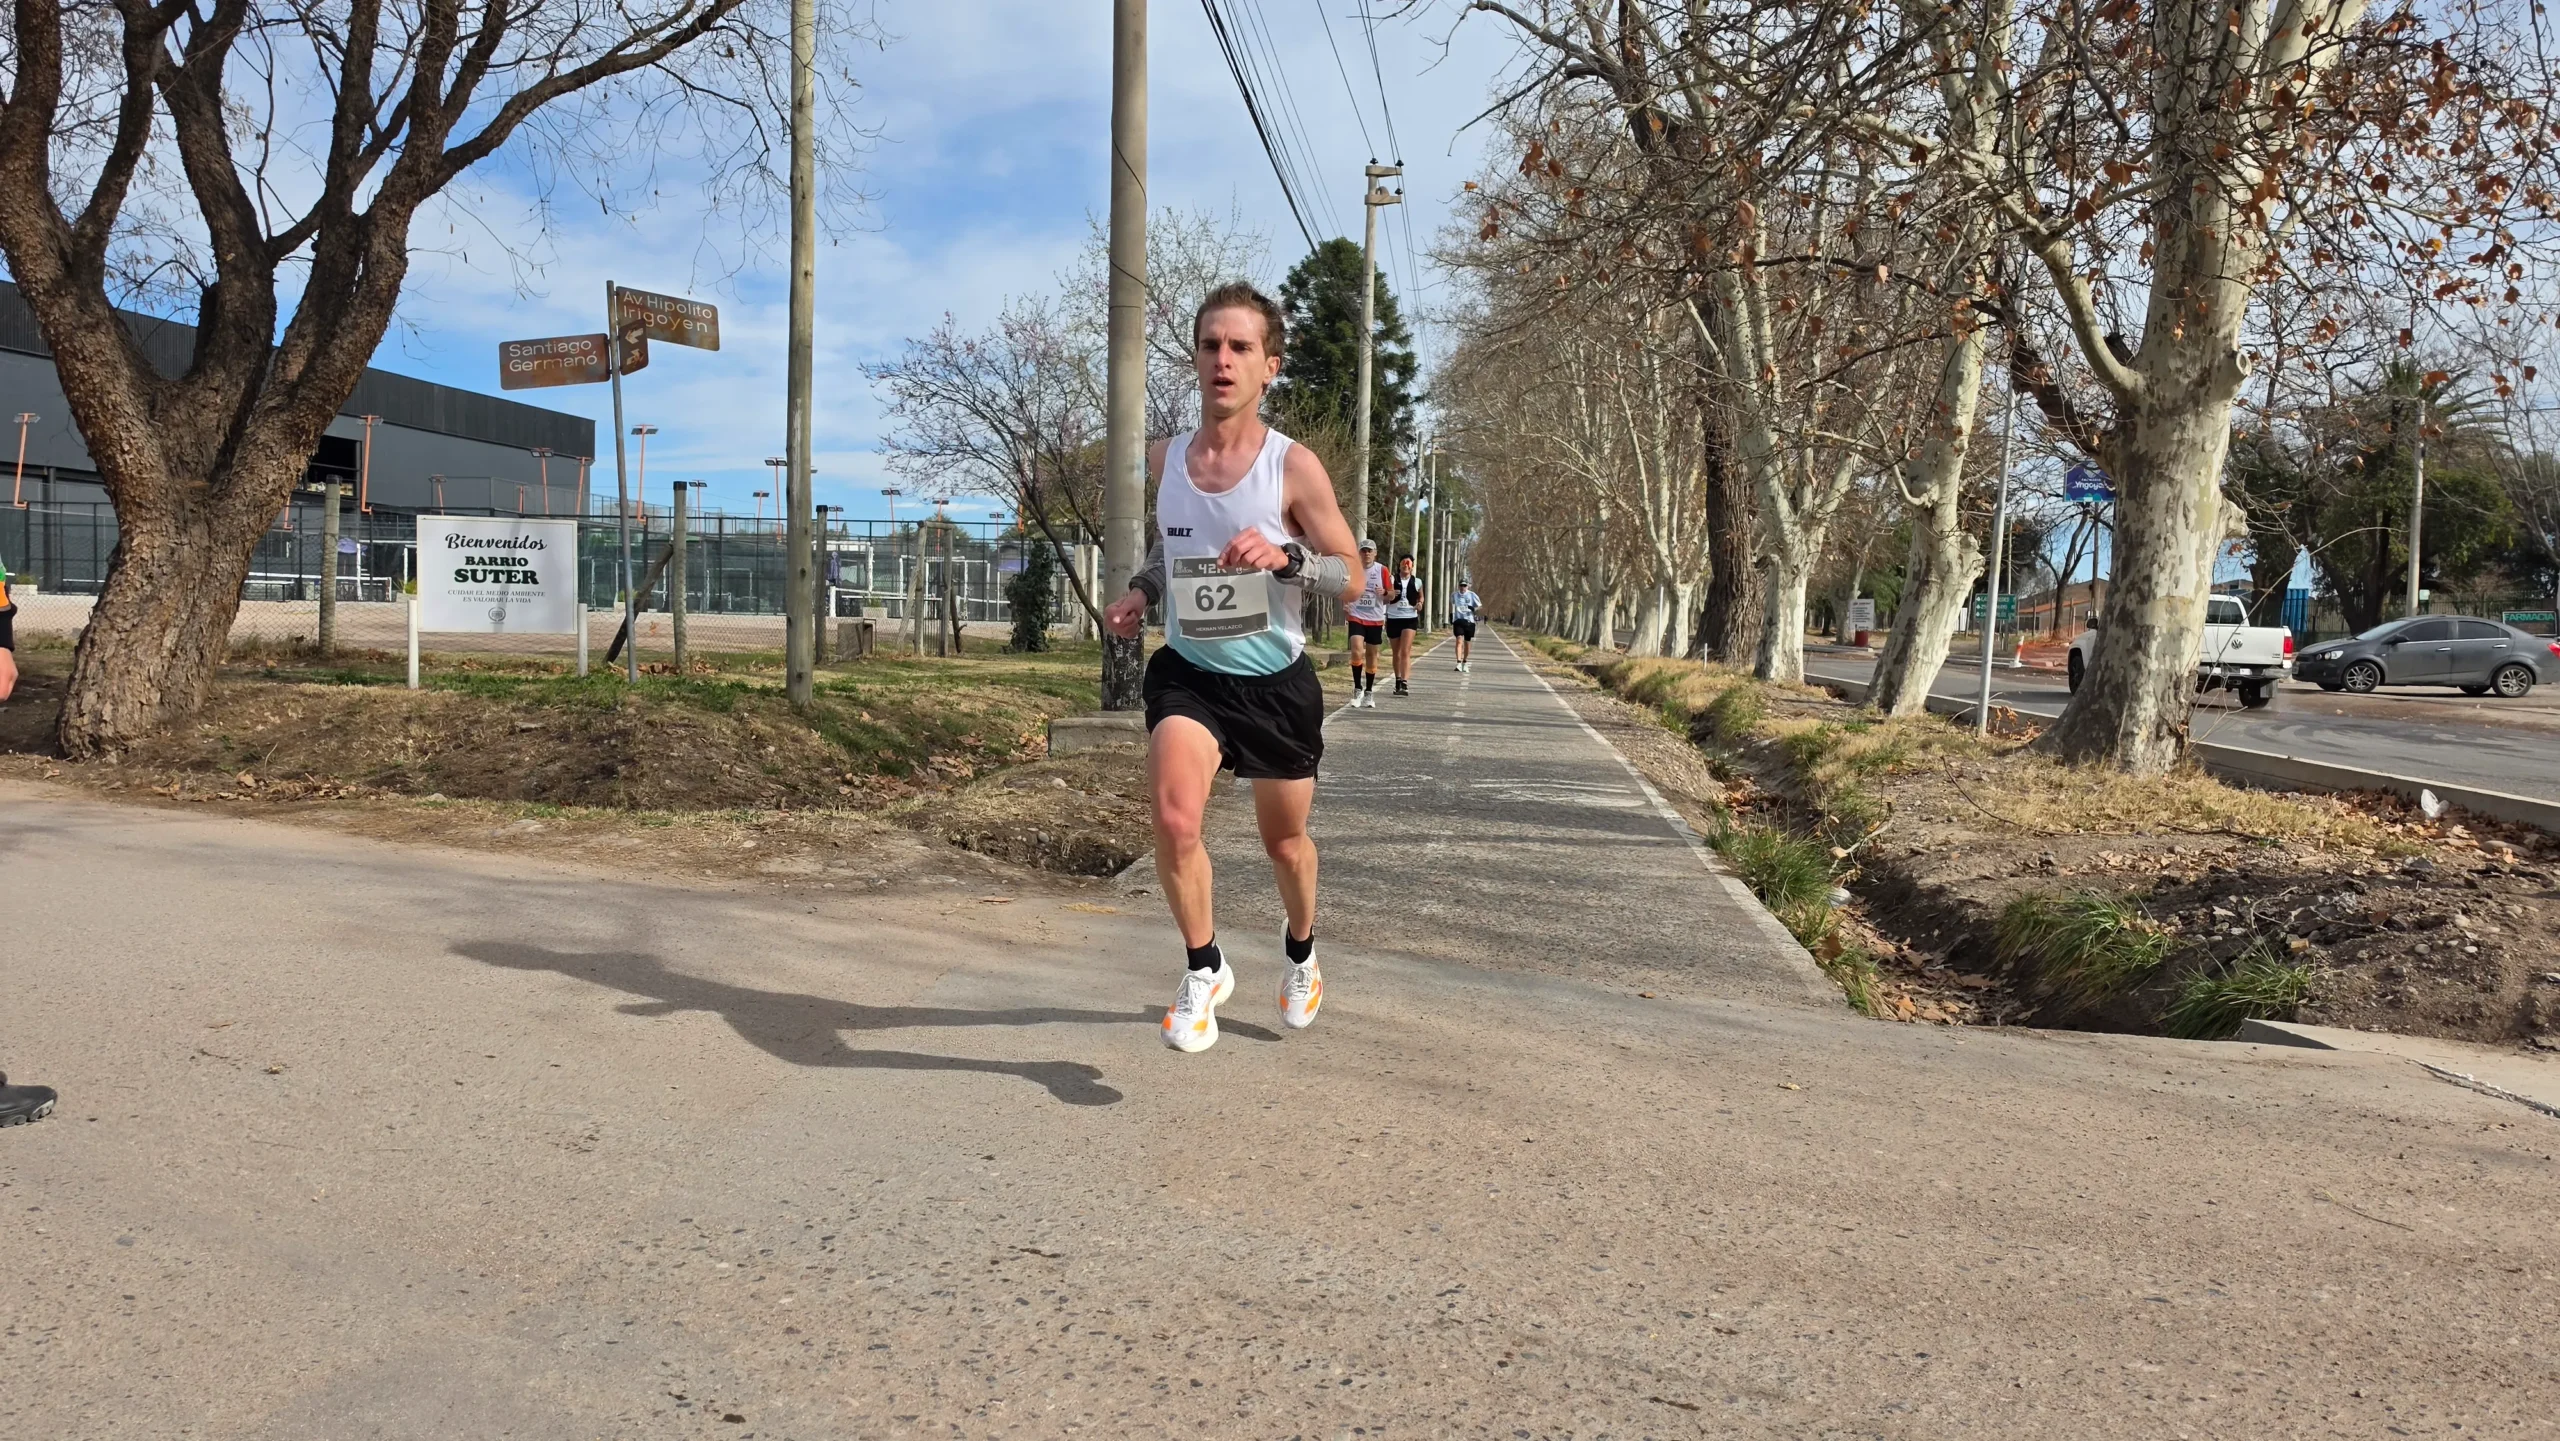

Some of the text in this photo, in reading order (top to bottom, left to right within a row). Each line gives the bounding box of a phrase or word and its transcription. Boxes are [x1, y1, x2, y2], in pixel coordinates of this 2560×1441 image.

[648, 297, 713, 319] Hipolito
[623, 305, 708, 333] Irigoyen
[509, 340, 592, 358] Santiago
[509, 351, 598, 373] Germanó
[445, 533, 548, 551] Bienvenidos
[465, 556, 529, 567] BARRIO
[454, 568, 540, 585] SUTER
[1195, 584, 1237, 612] 62
[2504, 613, 2555, 621] FARMACIA
